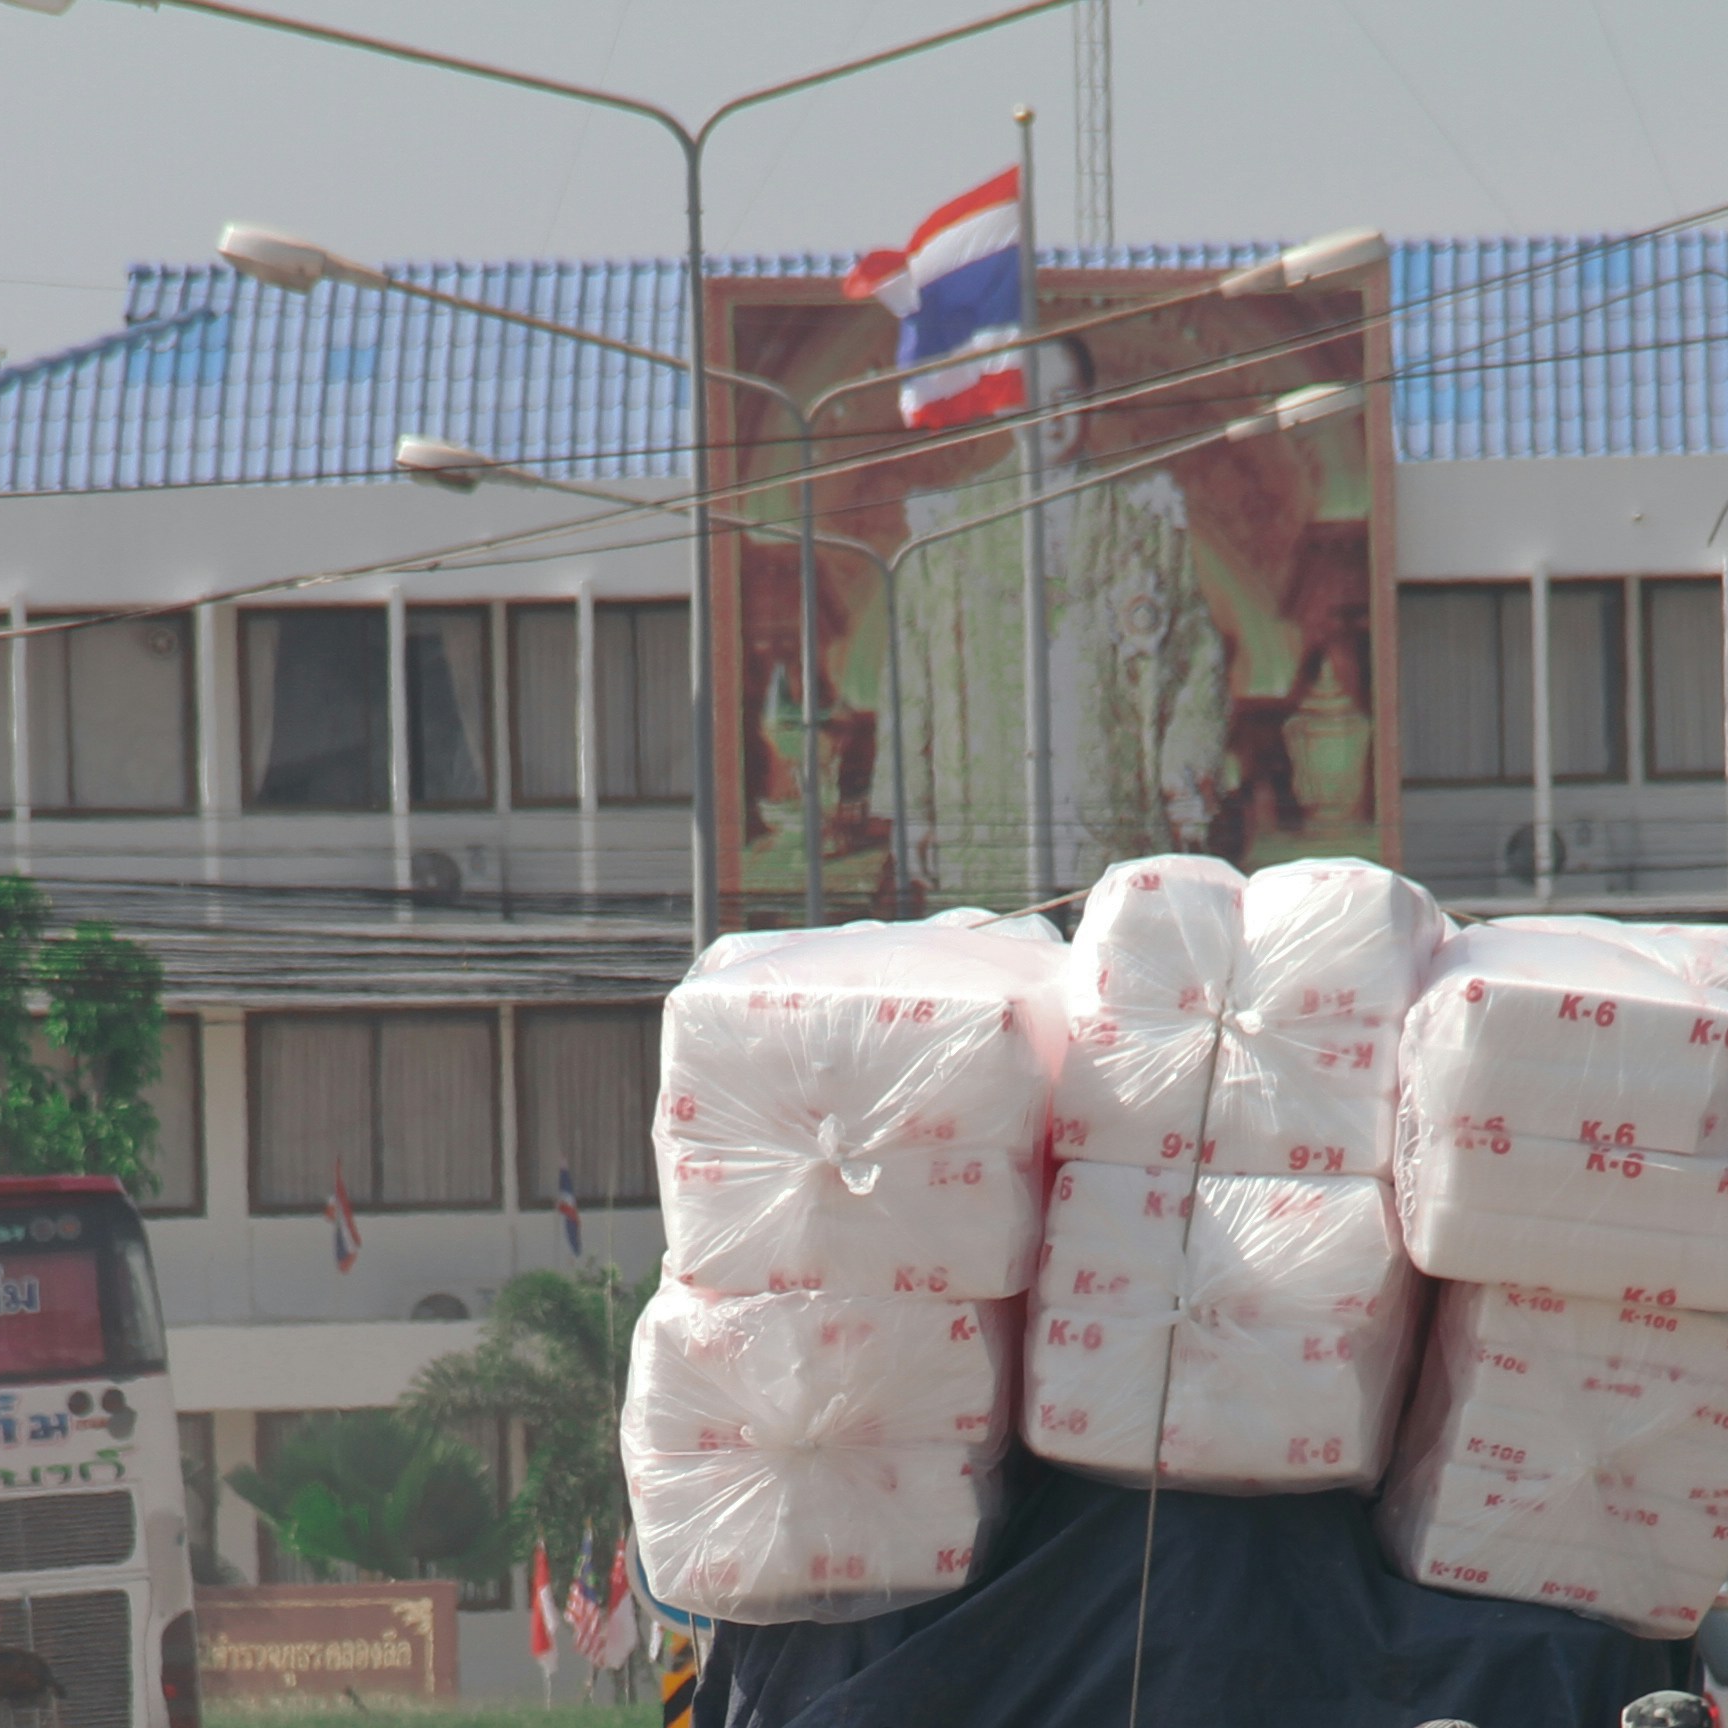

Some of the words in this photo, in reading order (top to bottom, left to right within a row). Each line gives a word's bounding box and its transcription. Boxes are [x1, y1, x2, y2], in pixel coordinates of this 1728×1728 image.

[1558, 993, 1618, 1027] K-6
[1287, 1145, 1345, 1174] K-6
[1619, 1308, 1678, 1332] K-106
[1047, 1319, 1103, 1350] K-6
[1287, 1438, 1342, 1465] K-6
[1429, 1561, 1489, 1585] K-106
